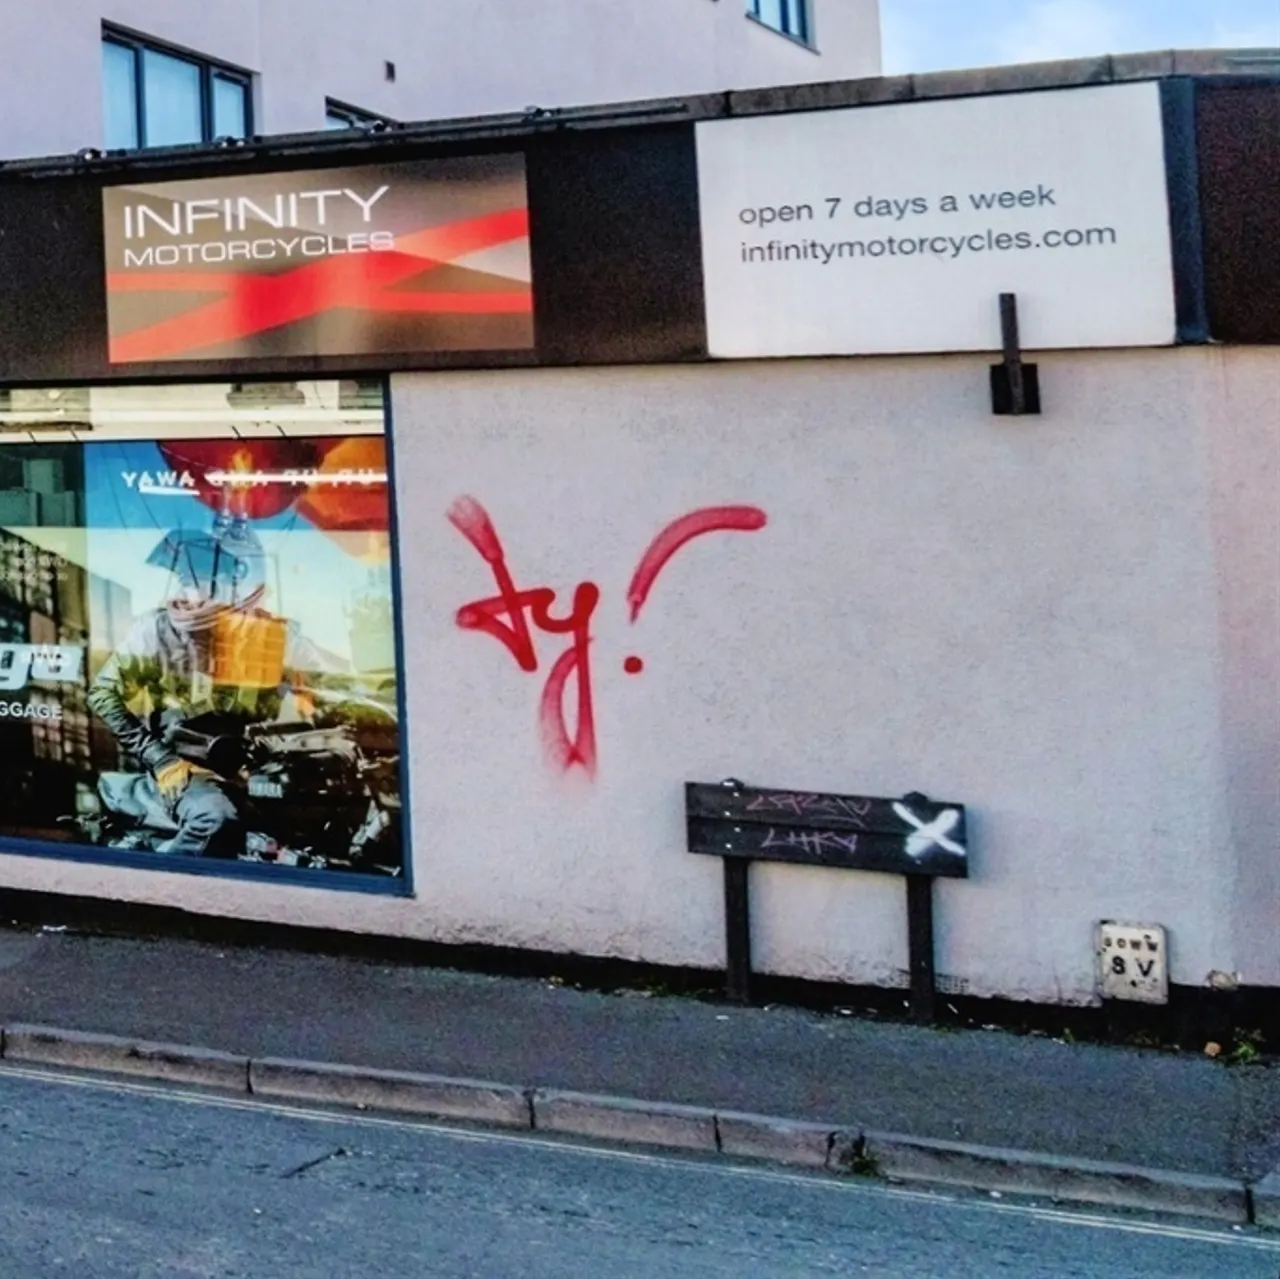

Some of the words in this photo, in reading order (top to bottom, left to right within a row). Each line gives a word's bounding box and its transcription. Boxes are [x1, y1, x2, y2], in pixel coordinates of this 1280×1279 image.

[124, 185, 389, 239] INFINITY
[738, 204, 814, 228] open
[823, 197, 842, 220] 7
[853, 195, 929, 221] days
[939, 195, 958, 213] a
[970, 184, 1057, 210] week
[124, 231, 397, 268] MOTORCYCLES
[740, 225, 1118, 265] infinitymotorcycles.com
